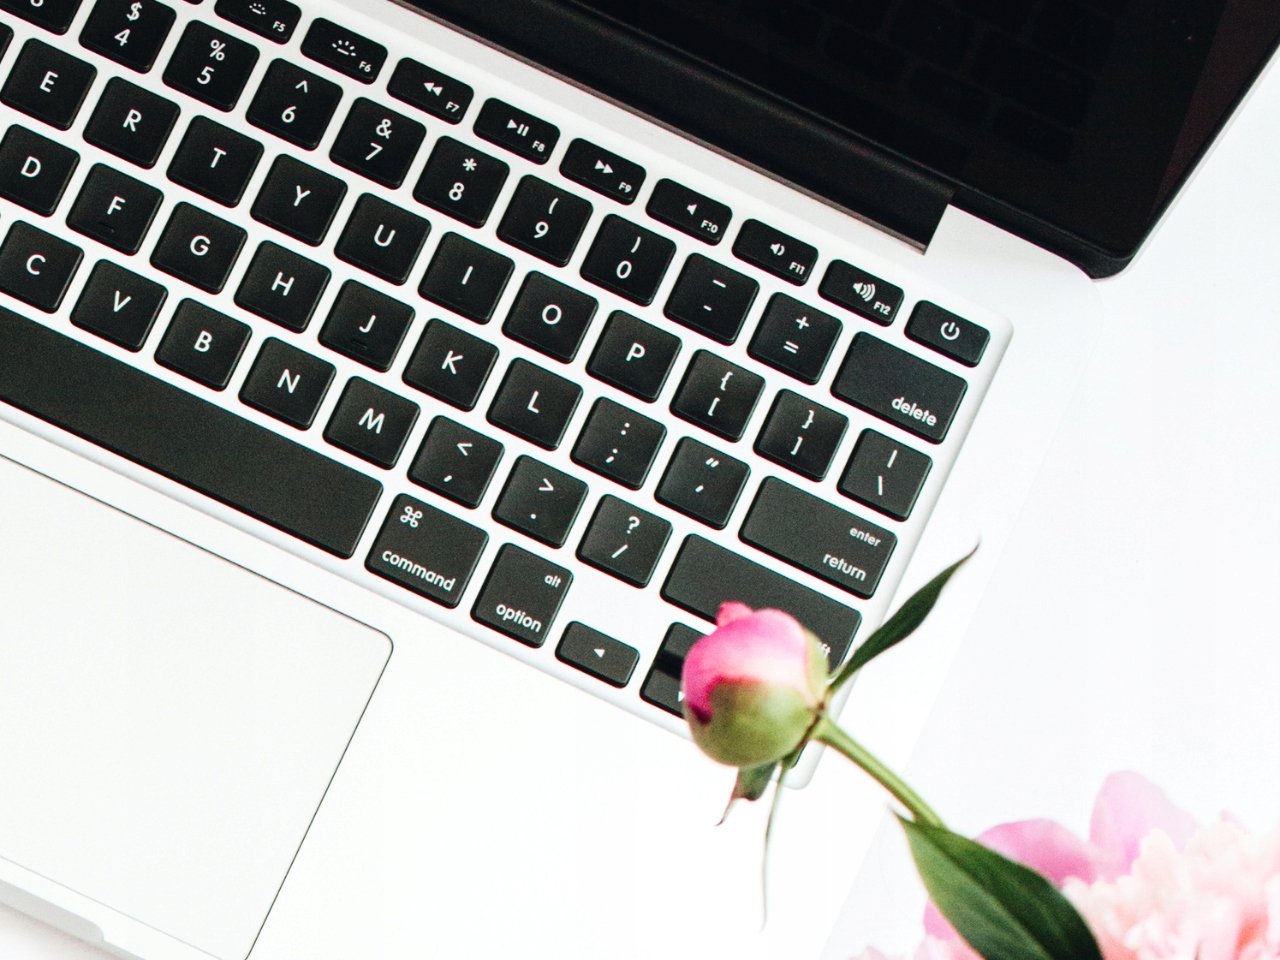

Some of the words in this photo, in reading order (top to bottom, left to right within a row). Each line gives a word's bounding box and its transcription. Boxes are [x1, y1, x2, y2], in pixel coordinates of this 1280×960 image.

[272, 20, 286, 32] F5
[114, 28, 131, 47] 4
[196, 66, 214, 85] 5
[359, 60, 372, 73] F6
[39, 70, 59, 93] E
[281, 105, 297, 123] 6
[445, 101, 460, 113] F7
[122, 109, 142, 132] R
[365, 142, 383, 161] 7
[532, 140, 545, 152] F8
[20, 156, 41, 178] D
[210, 147, 227, 168] T
[293, 185, 311, 207] Y
[448, 182, 465, 201] 8
[618, 181, 632, 193] F9
[107, 195, 126, 215] F
[374, 224, 396, 247] U
[533, 221, 549, 239] 9
[190, 235, 211, 256] G
[26, 254, 46, 276] C
[461, 265, 474, 285] I
[616, 260, 632, 279] 0
[789, 261, 805, 275] F11
[271, 273, 295, 296] H
[113, 290, 132, 313] V
[874, 302, 891, 315] F12
[359, 314, 376, 333] J
[541, 304, 562, 325] O
[193, 330, 213, 352] B
[441, 350, 463, 375] K
[626, 342, 646, 362] P
[277, 368, 301, 394] N
[527, 390, 539, 414] L
[891, 397, 937, 426] delete
[358, 407, 385, 434] M
[849, 526, 882, 547] enter
[381, 550, 456, 592] command
[823, 554, 867, 582] return
[544, 575, 562, 588] alt
[495, 604, 542, 633] option
